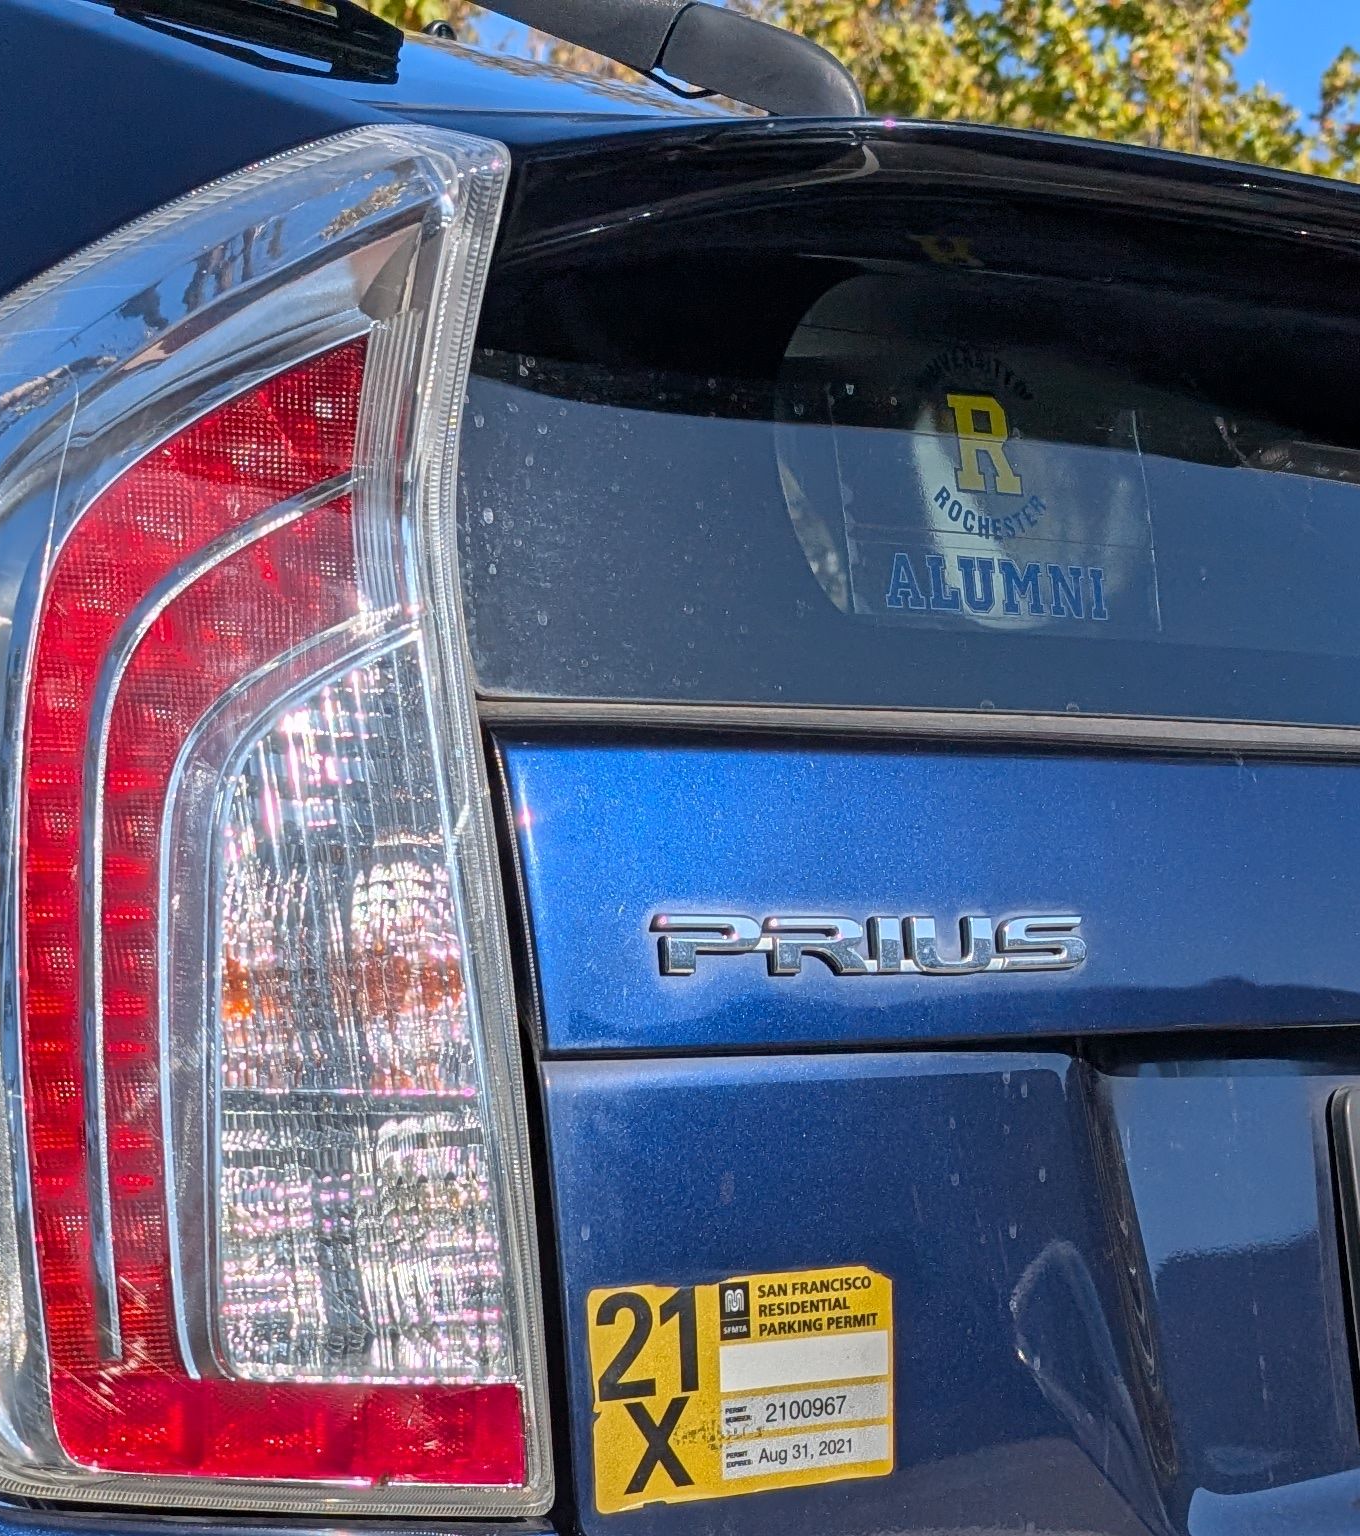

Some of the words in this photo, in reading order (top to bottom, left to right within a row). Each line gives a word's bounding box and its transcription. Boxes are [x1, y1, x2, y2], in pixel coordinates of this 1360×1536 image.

[947, 394, 1024, 496] R
[933, 485, 1046, 540] ROCHESTER
[886, 553, 1108, 621] ALUMNI
[649, 913, 1088, 976] PRIUS
[758, 1283, 788, 1298] SAN
[792, 1276, 871, 1296] FRANCISCO
[759, 1297, 850, 1318] RESIDENTIAL
[596, 1285, 699, 1402] 21
[759, 1318, 823, 1337] PARKING
[827, 1313, 878, 1330] PERMIT
[766, 1395, 847, 1423] 2100967
[624, 1396, 695, 1495] X
[758, 1447, 788, 1465] Aug
[792, 1443, 814, 1460] 31,
[819, 1438, 852, 1456] 2021
